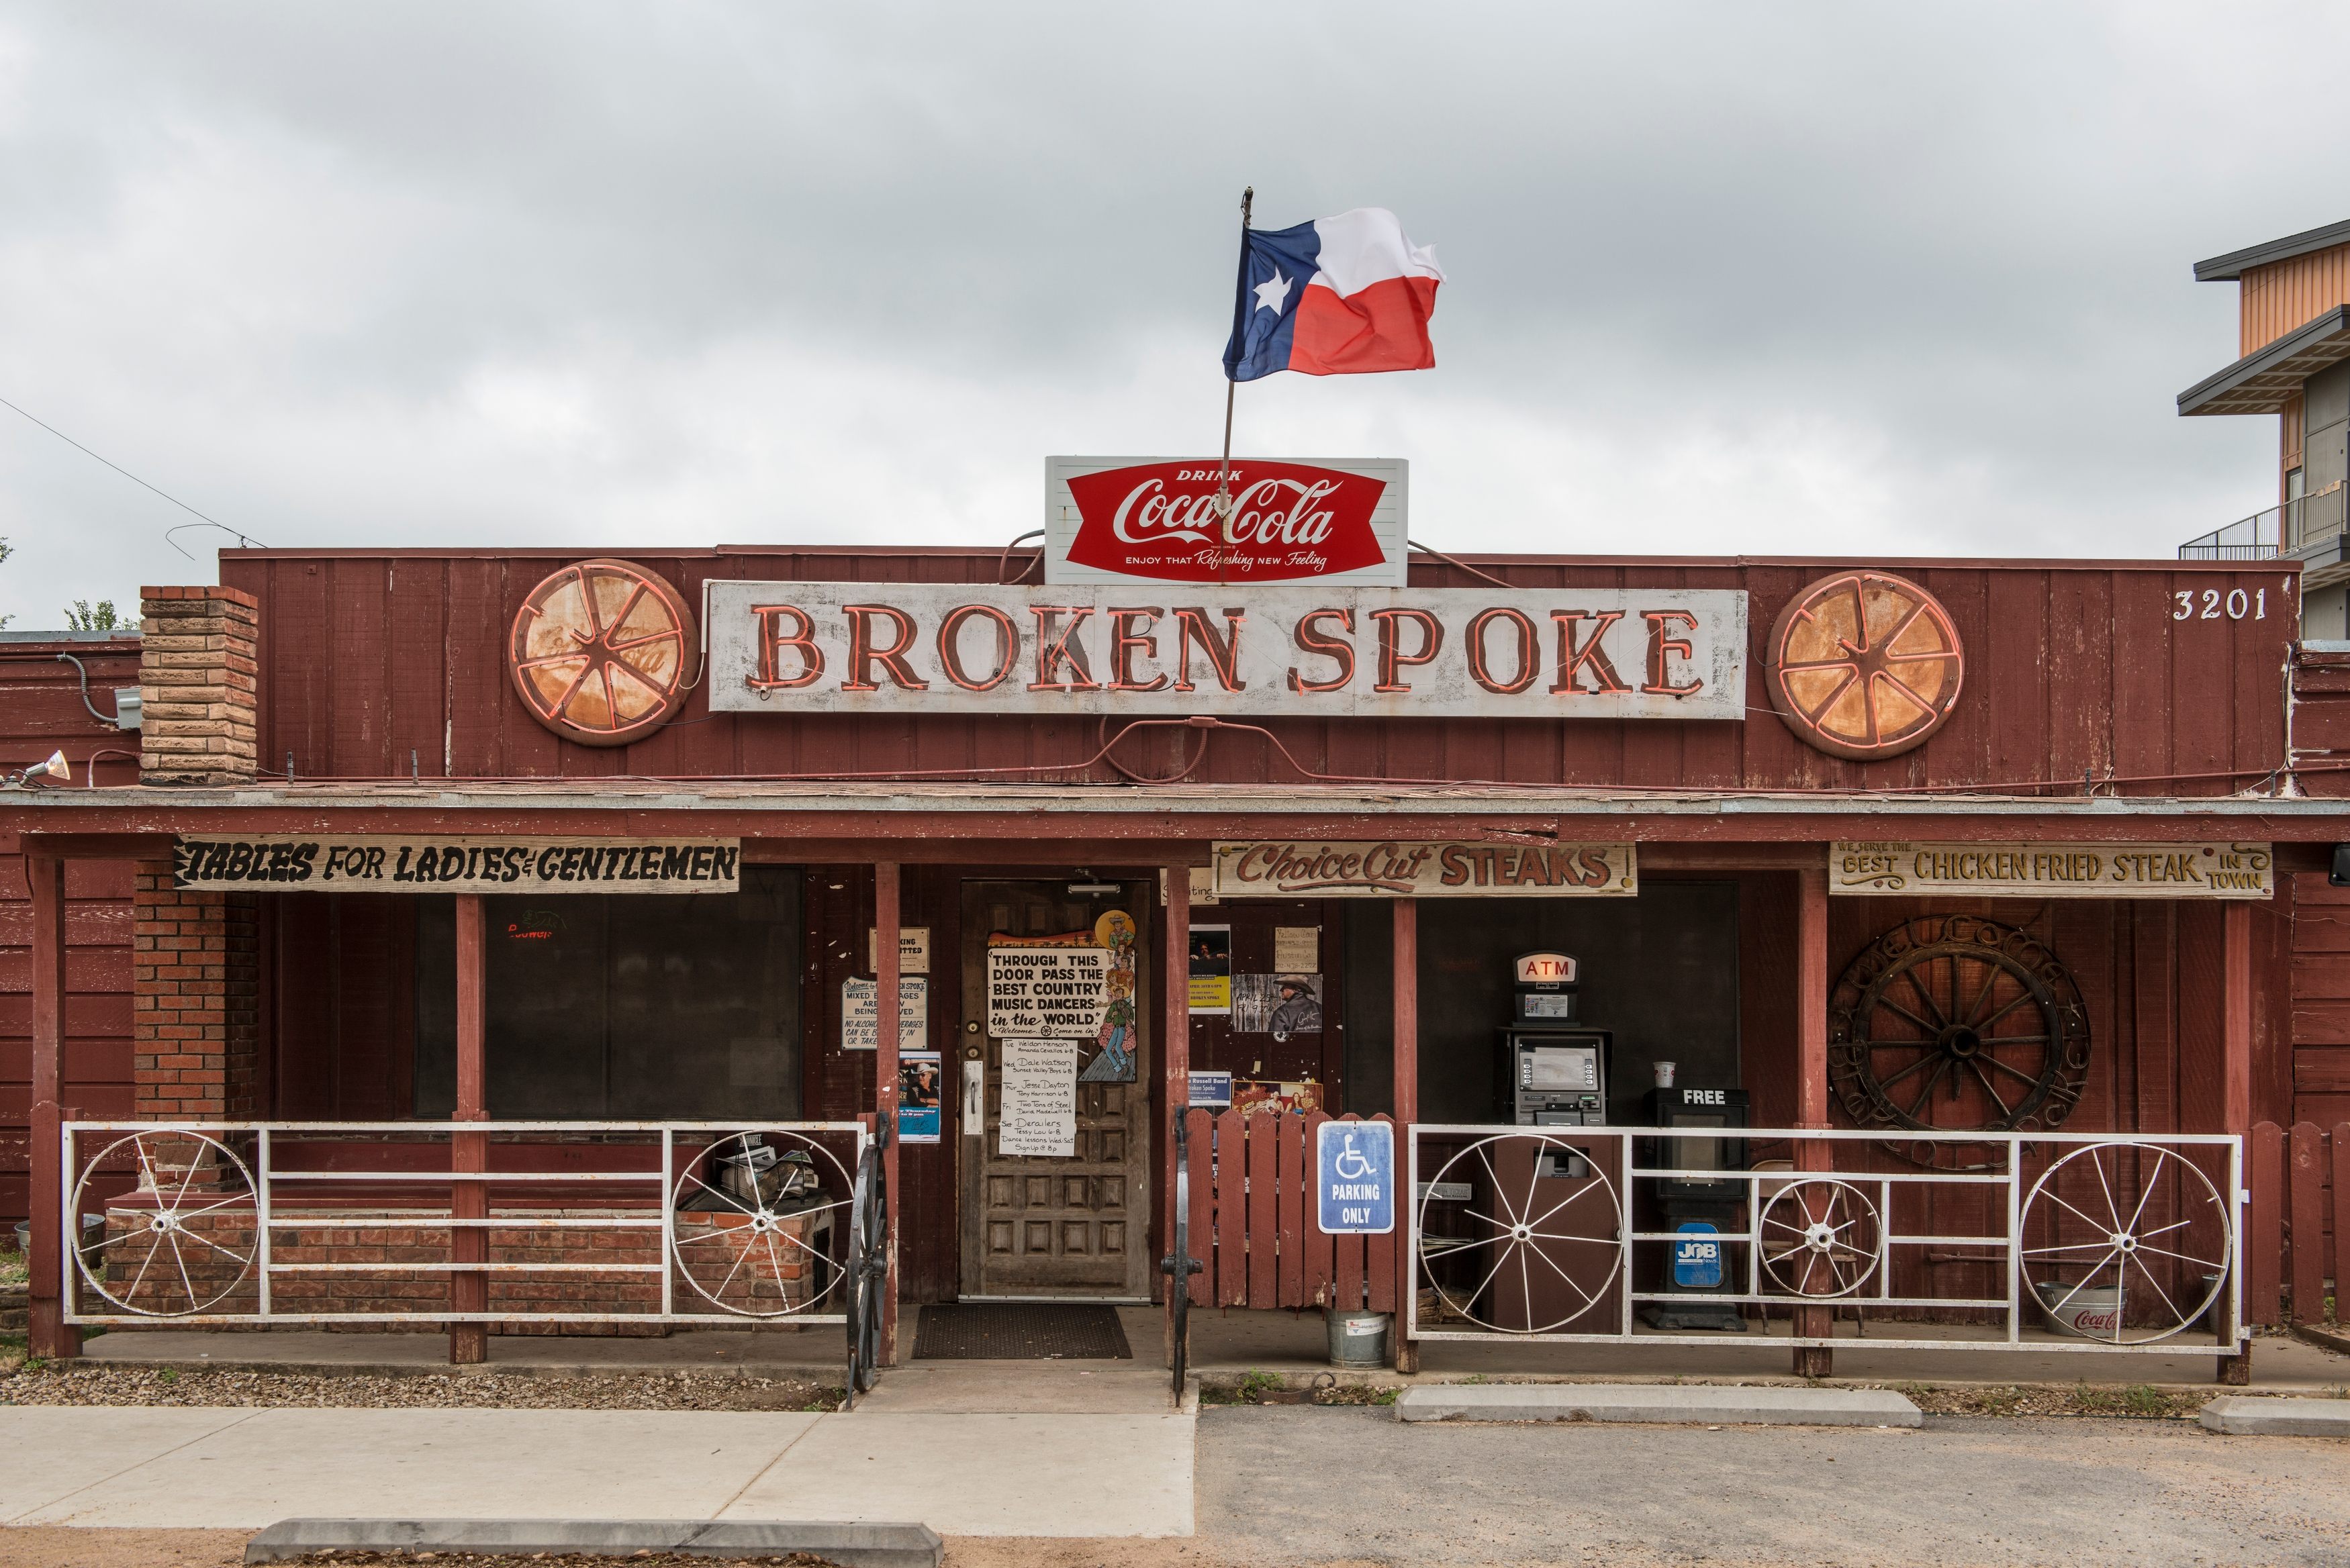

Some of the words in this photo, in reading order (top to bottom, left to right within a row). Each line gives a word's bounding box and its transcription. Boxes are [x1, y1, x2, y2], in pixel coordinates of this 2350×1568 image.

[1176, 470, 1243, 481] DRINK
[1194, 549, 1254, 571] Refreshing
[1284, 550, 1327, 572] Feeling
[2173, 588, 2265, 620] 3201
[744, 603, 1247, 693] BROKEN
[1287, 607, 1705, 696] SPOKE
[1838, 842, 1853, 851] WE
[1859, 842, 1888, 852] SERVE
[183, 842, 320, 881] TABLES
[323, 846, 386, 880] FOR
[393, 846, 528, 882] LADIES
[536, 846, 739, 881] GENTLEMEN
[1237, 844, 1361, 882] Choice
[1362, 843, 1433, 881] Cut
[1440, 845, 1611, 888] STEAKS
[1843, 854, 1899, 873] BEST
[1914, 850, 2030, 881] CHICKEN
[2034, 852, 2103, 881] FRIED
[2112, 852, 2202, 882] STEAK
[2220, 854, 2241, 869] IN
[2206, 872, 2262, 889] TOWN
[1068, 956, 1098, 966] THIS
[1525, 961, 1568, 975] ATM
[993, 969, 1034, 980] DOOR
[1042, 969, 1075, 980] PASS
[1079, 969, 1103, 980] THE
[844, 983, 869, 991] Welcome
[906, 983, 925, 991] SPOKE
[994, 983, 1027, 995] BEST
[1033, 983, 1102, 995] COUNTRY
[1237, 993, 1258, 1002] APRIL
[992, 999, 1033, 1010] MUSIC
[1037, 998, 1095, 1010] DANCERS
[990, 1013, 1008, 1026] in
[1010, 1013, 1041, 1026] the
[1017, 1058, 1039, 1066] Dale
[1041, 1059, 1072, 1067] Watson
[1003, 1082, 1017, 1090] Thur
[1021, 1080, 1041, 1089] Jesse
[1040, 1079, 1070, 1089] Dayton
[1683, 1089, 1726, 1105] FREE
[1047, 1101, 1053, 1110] of
[1015, 1118, 1061, 1127] Derailers
[1015, 1128, 1032, 1136] Tessy
[1332, 1184, 1380, 1200] PARKING
[1342, 1208, 1370, 1224] ONLY
[1678, 1243, 1717, 1259] JOB
